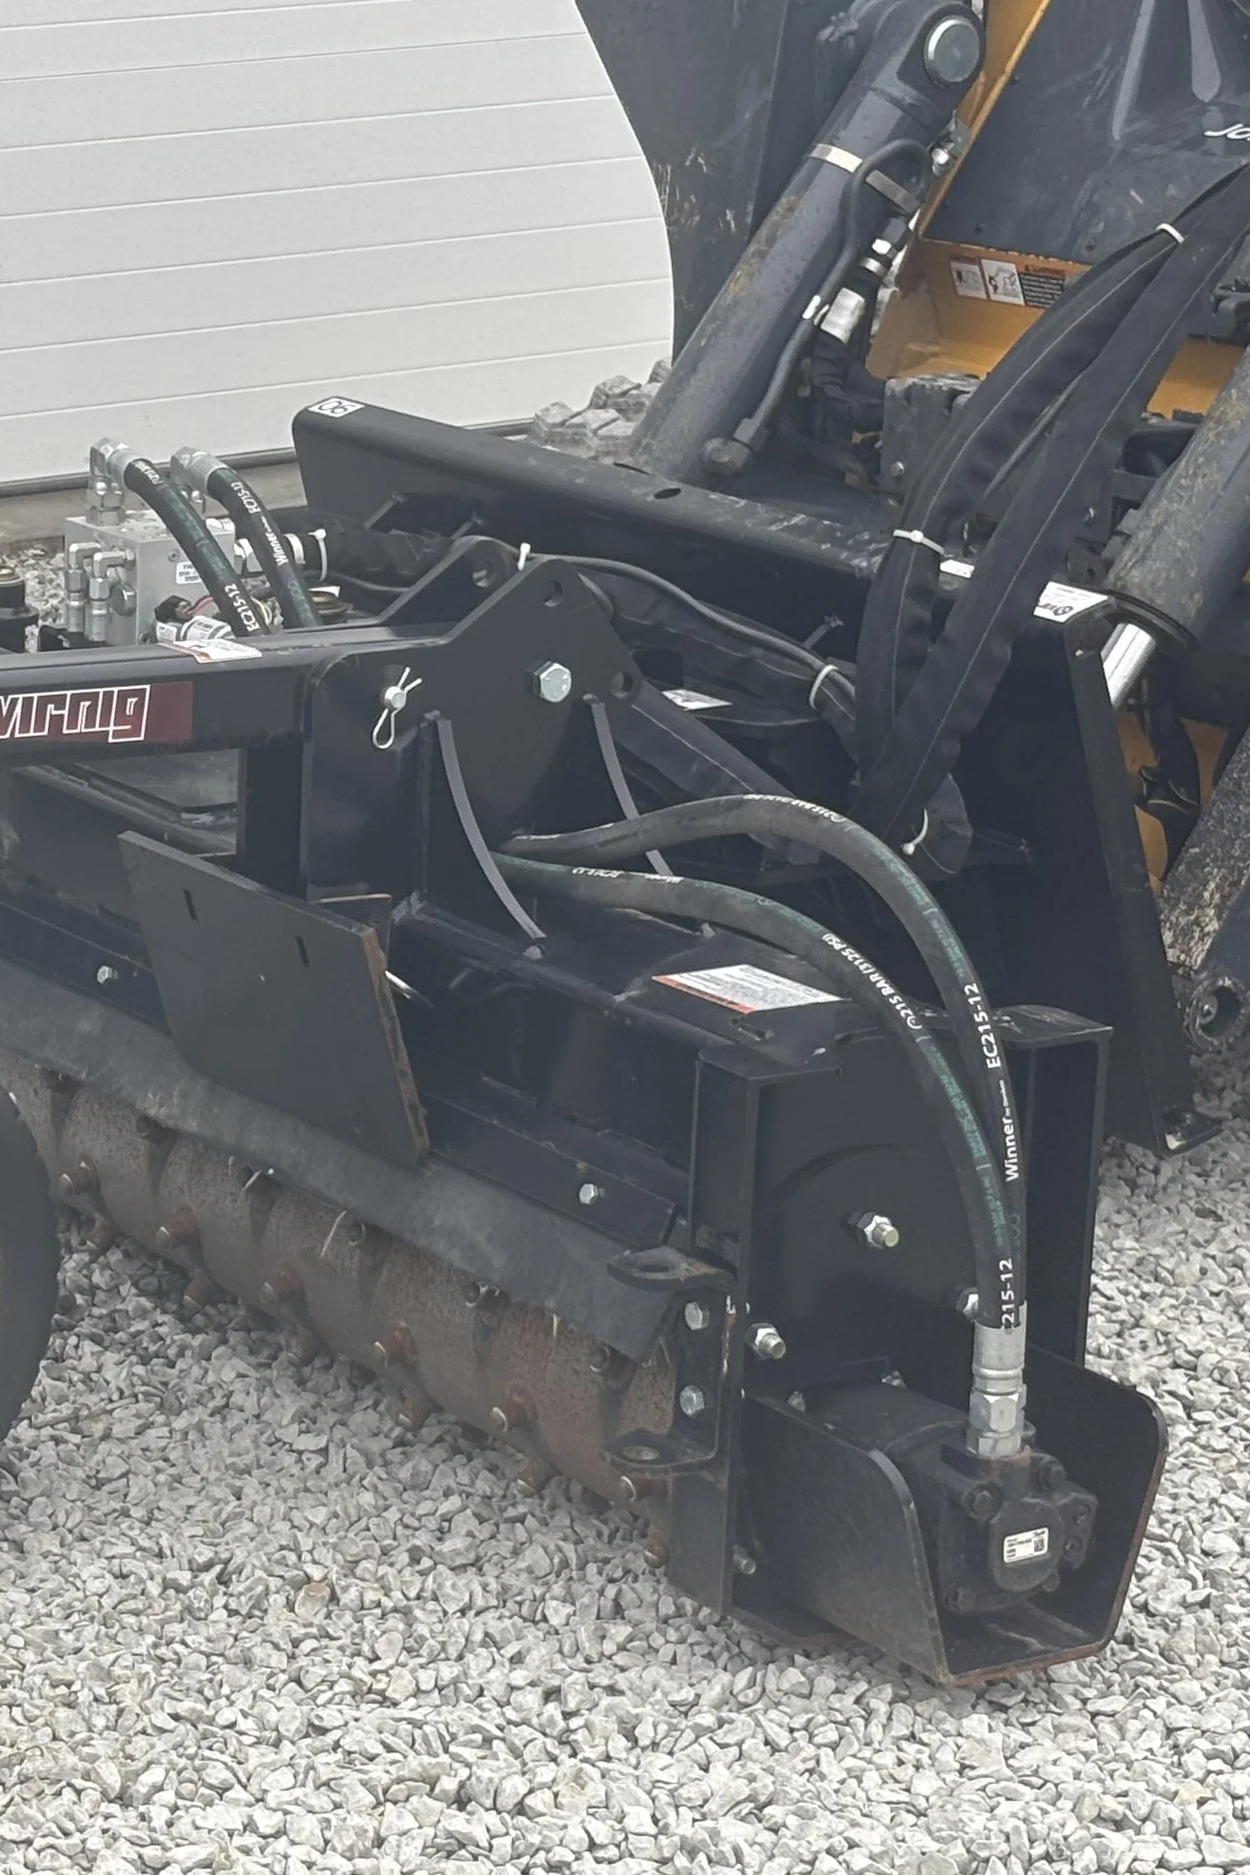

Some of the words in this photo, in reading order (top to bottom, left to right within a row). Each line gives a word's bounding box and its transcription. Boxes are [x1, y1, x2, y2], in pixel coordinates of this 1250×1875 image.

[1203, 123, 1250, 141] Jo
[224, 583, 261, 632] EC215-12
[964, 982, 1002, 1069] EC215-12
[1002, 1117, 1019, 1182] Winner
[999, 1258, 1015, 1329] 215-12
